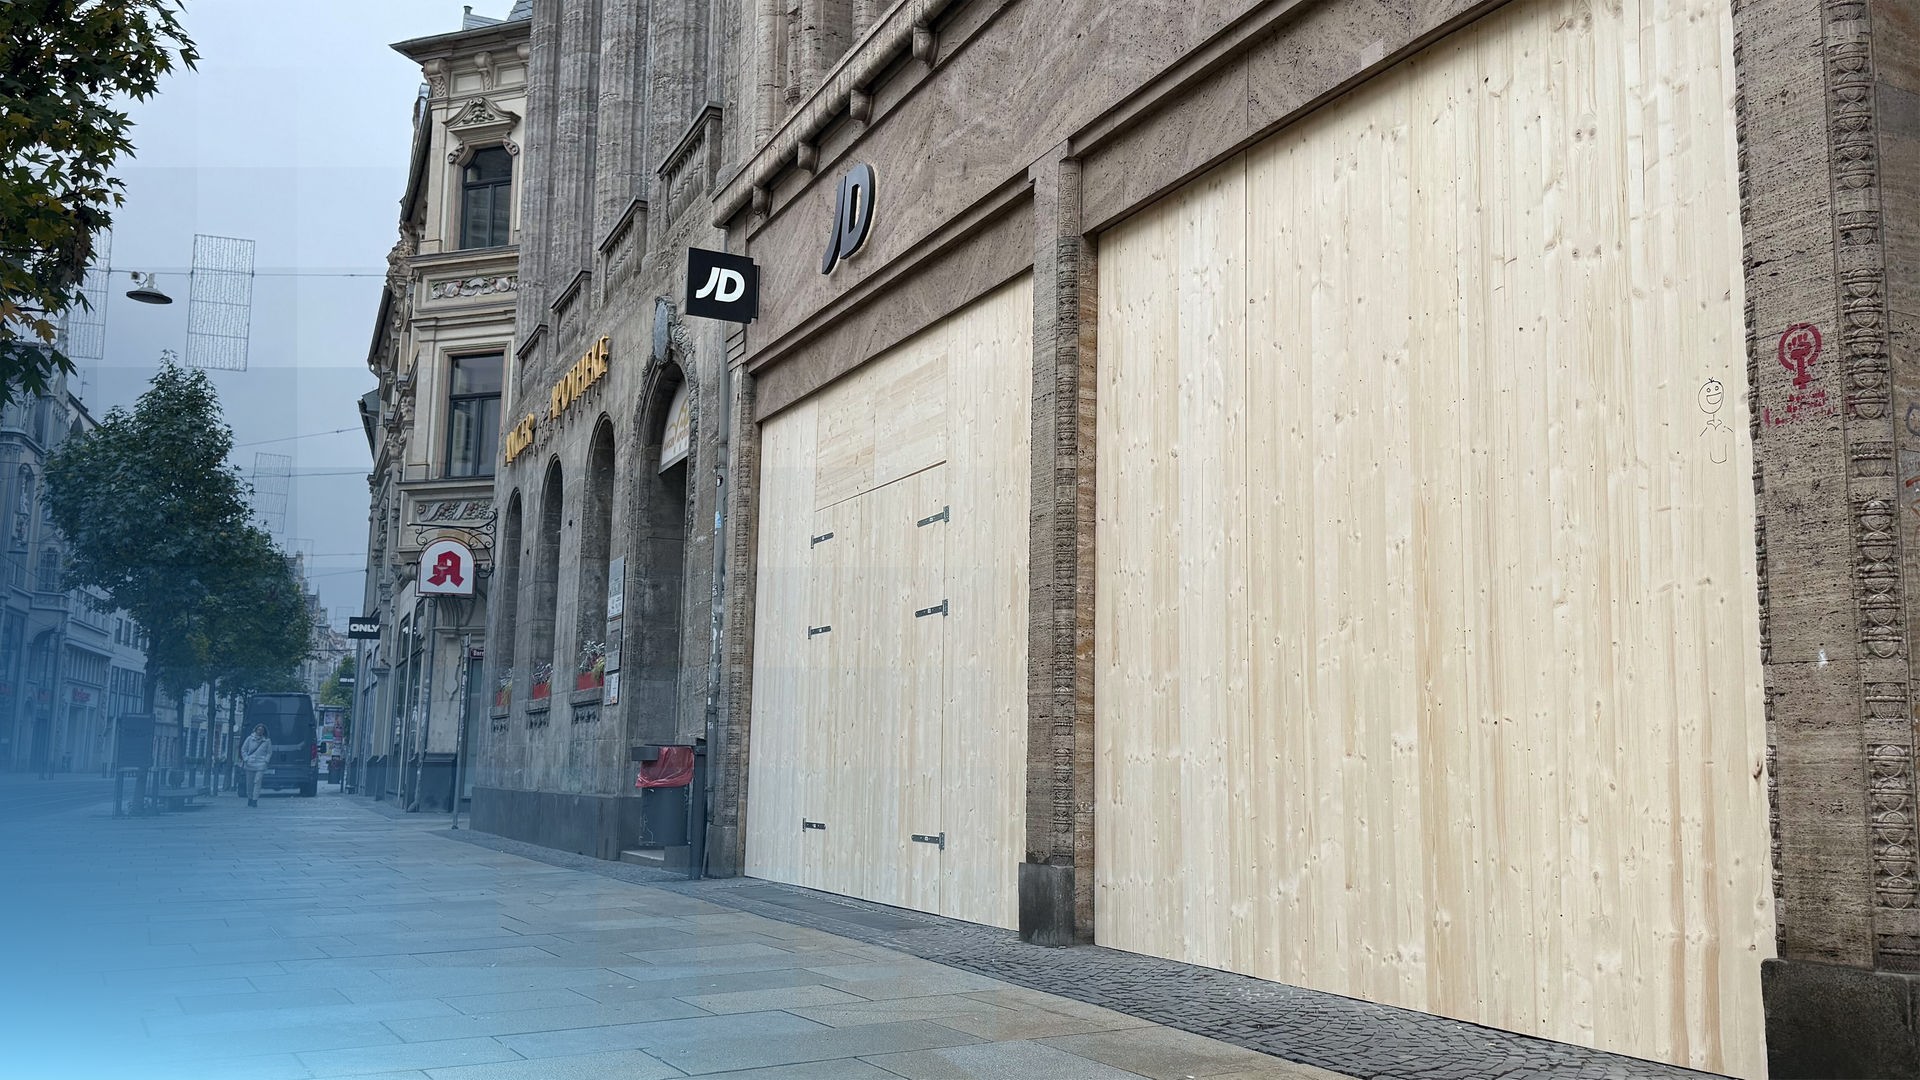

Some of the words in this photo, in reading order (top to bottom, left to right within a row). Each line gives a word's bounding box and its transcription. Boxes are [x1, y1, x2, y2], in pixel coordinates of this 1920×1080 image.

[822, 163, 875, 275] JD
[695, 266, 745, 303] JD
[350, 623, 380, 633] ONLY
